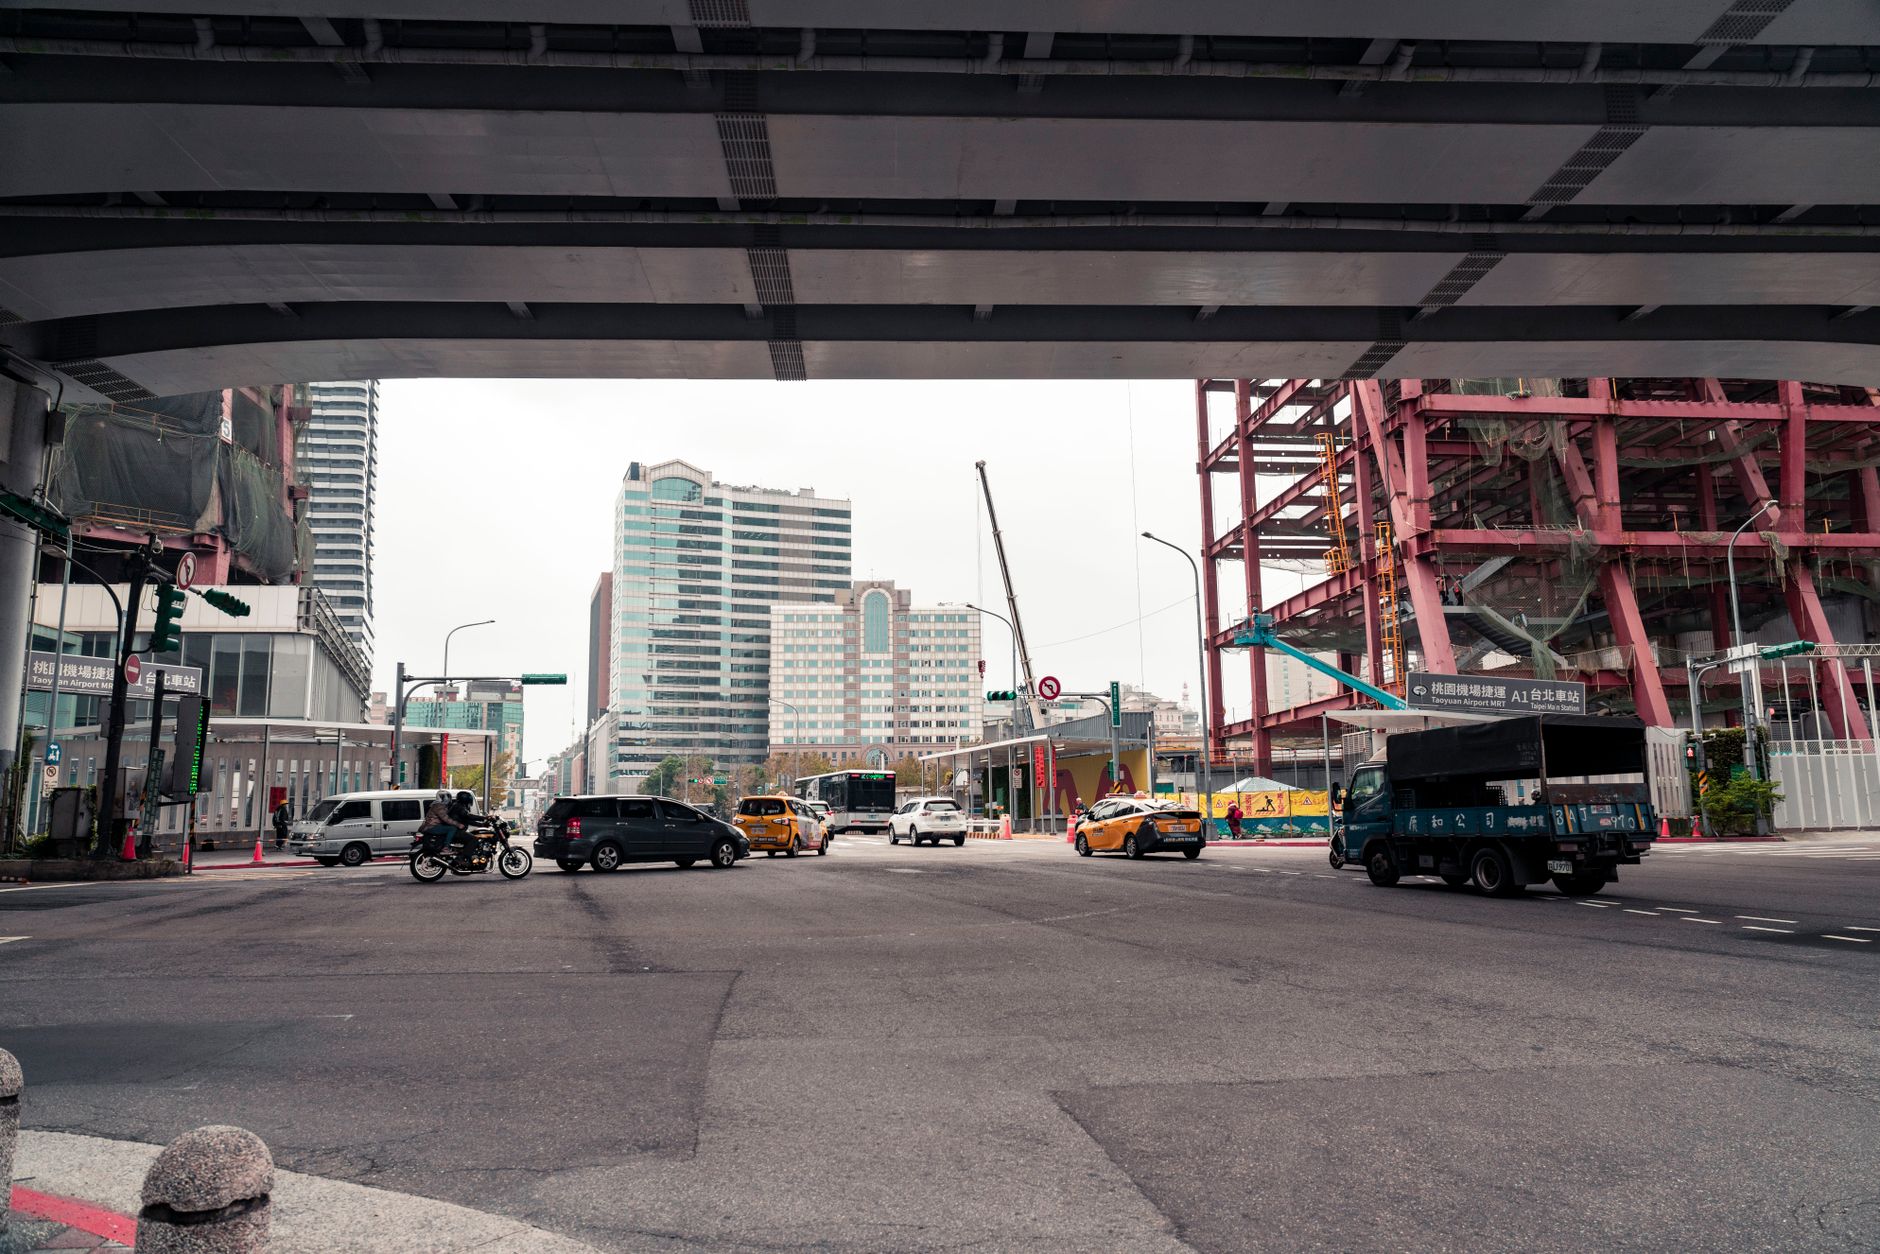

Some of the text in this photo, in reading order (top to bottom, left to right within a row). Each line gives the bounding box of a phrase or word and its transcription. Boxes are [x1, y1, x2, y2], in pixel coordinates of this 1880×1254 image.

[32, 675, 69, 686] Taoyan
[70, 679, 99, 688] Airport
[1431, 681, 1580, 703] 桃園機場捷運 A1 台北車站
[1431, 696, 1506, 708] Taoyuan Airport MRT
[1530, 702, 1580, 712] Taipei Main Station
